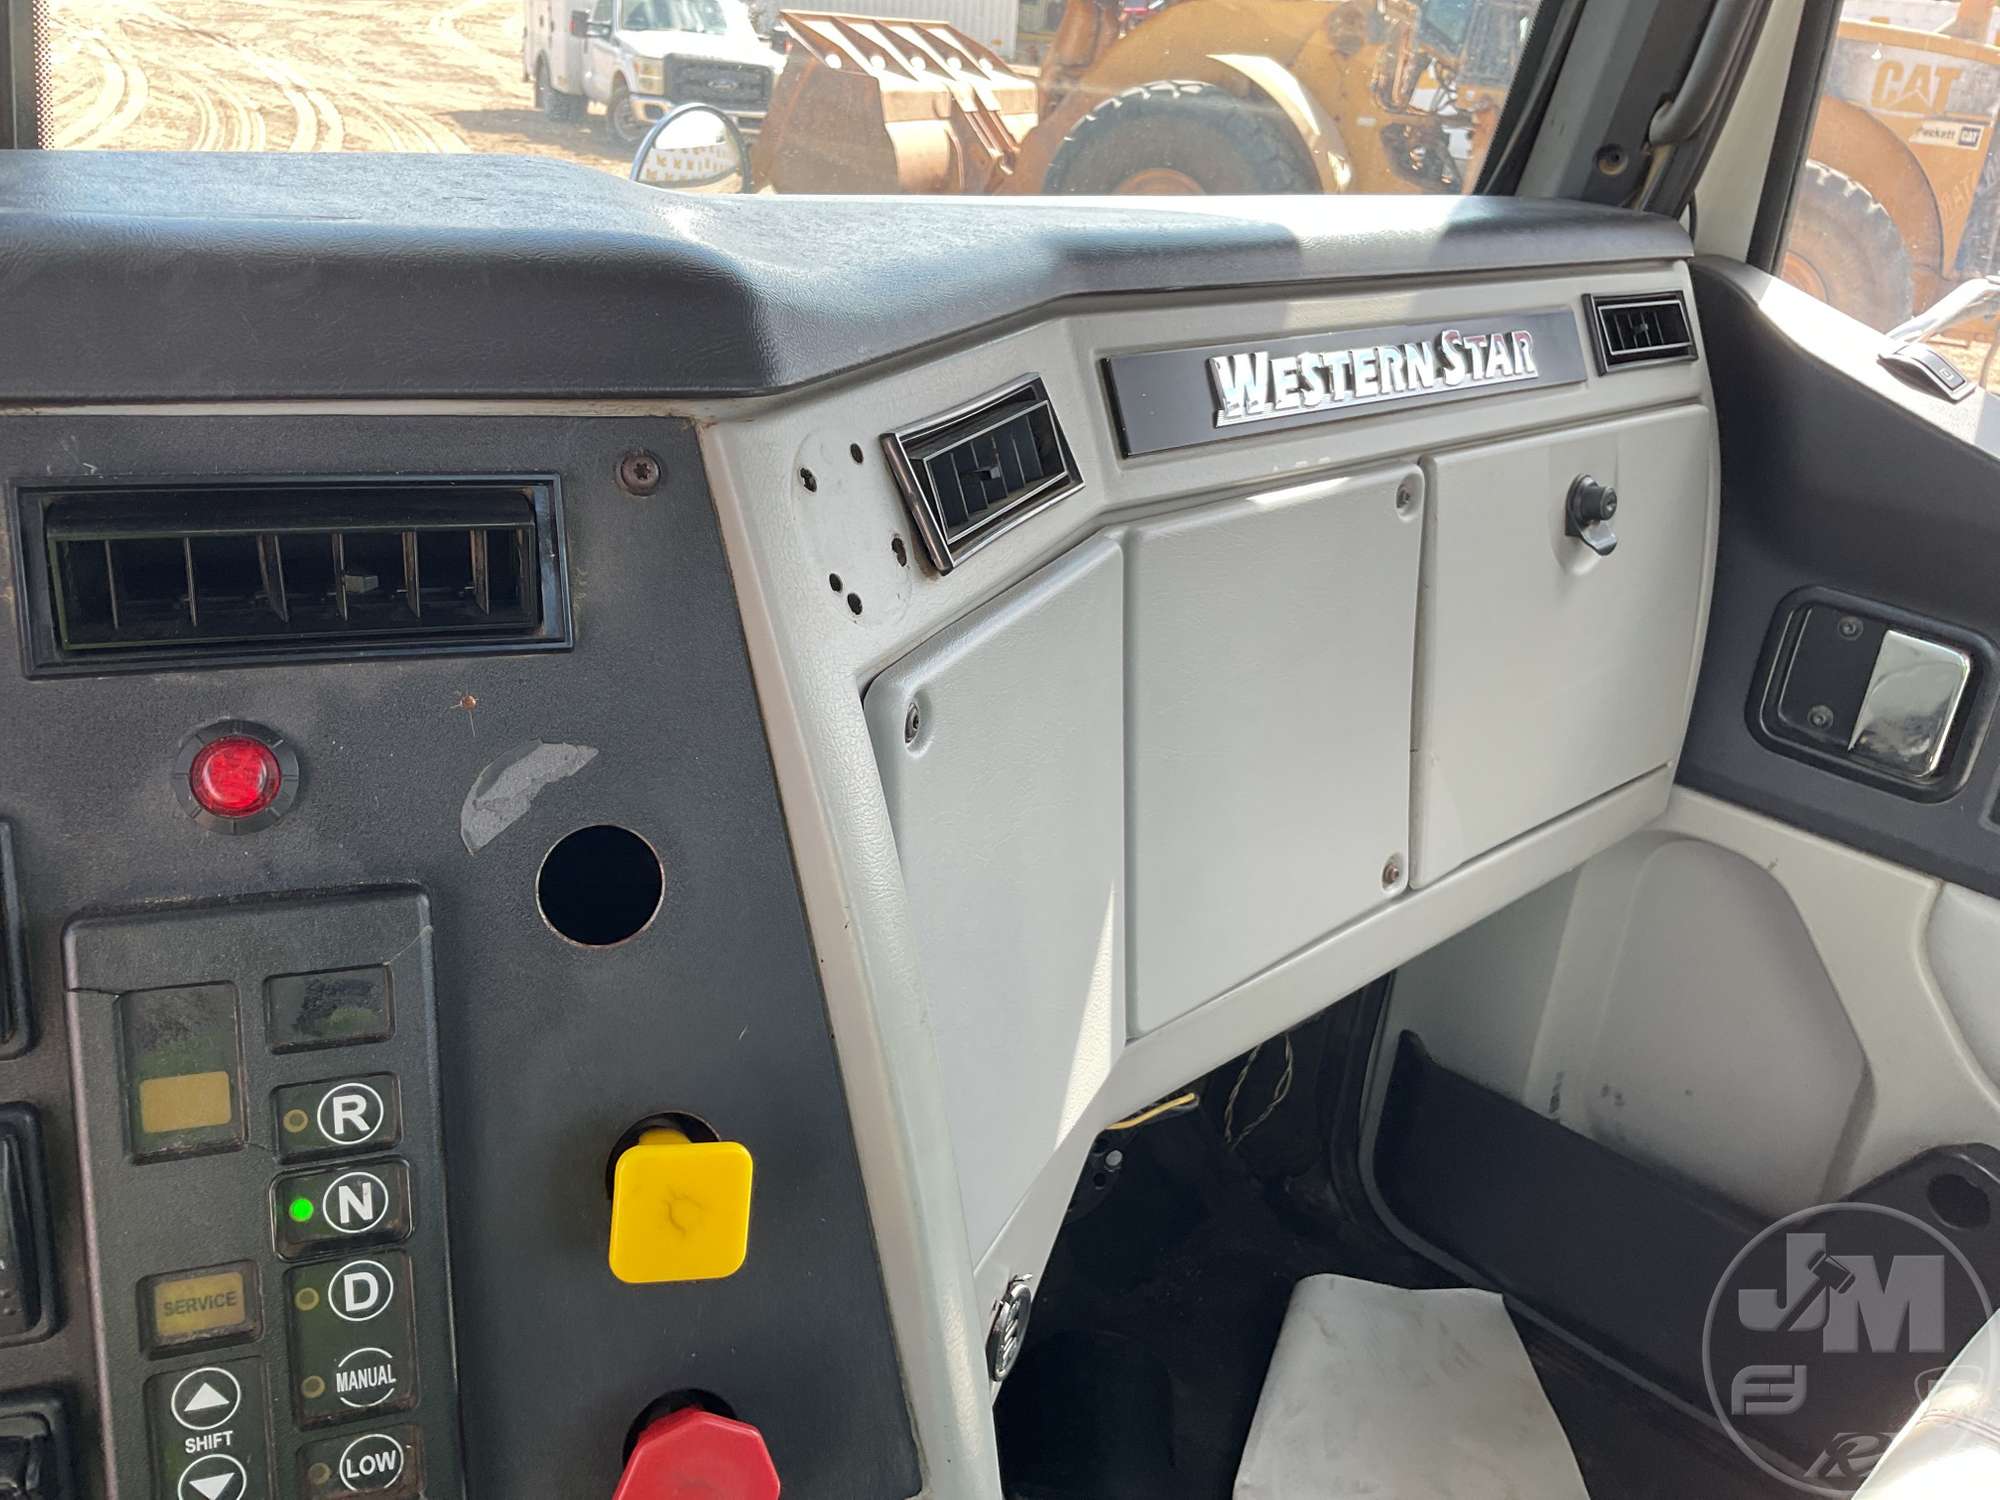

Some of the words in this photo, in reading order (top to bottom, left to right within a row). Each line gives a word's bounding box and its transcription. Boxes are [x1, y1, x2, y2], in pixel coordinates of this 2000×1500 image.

[1871, 61, 1962, 114] CAT
[1208, 341, 1436, 422] WESTERN
[1438, 329, 1537, 386] STAR
[332, 1096, 368, 1136] R
[338, 1181, 374, 1224] N
[162, 1289, 238, 1317] SERVICE
[344, 1272, 378, 1313] D
[336, 1363, 397, 1391] MANUAL
[184, 1430, 234, 1454] SHIFT
[346, 1450, 401, 1478] LOW
